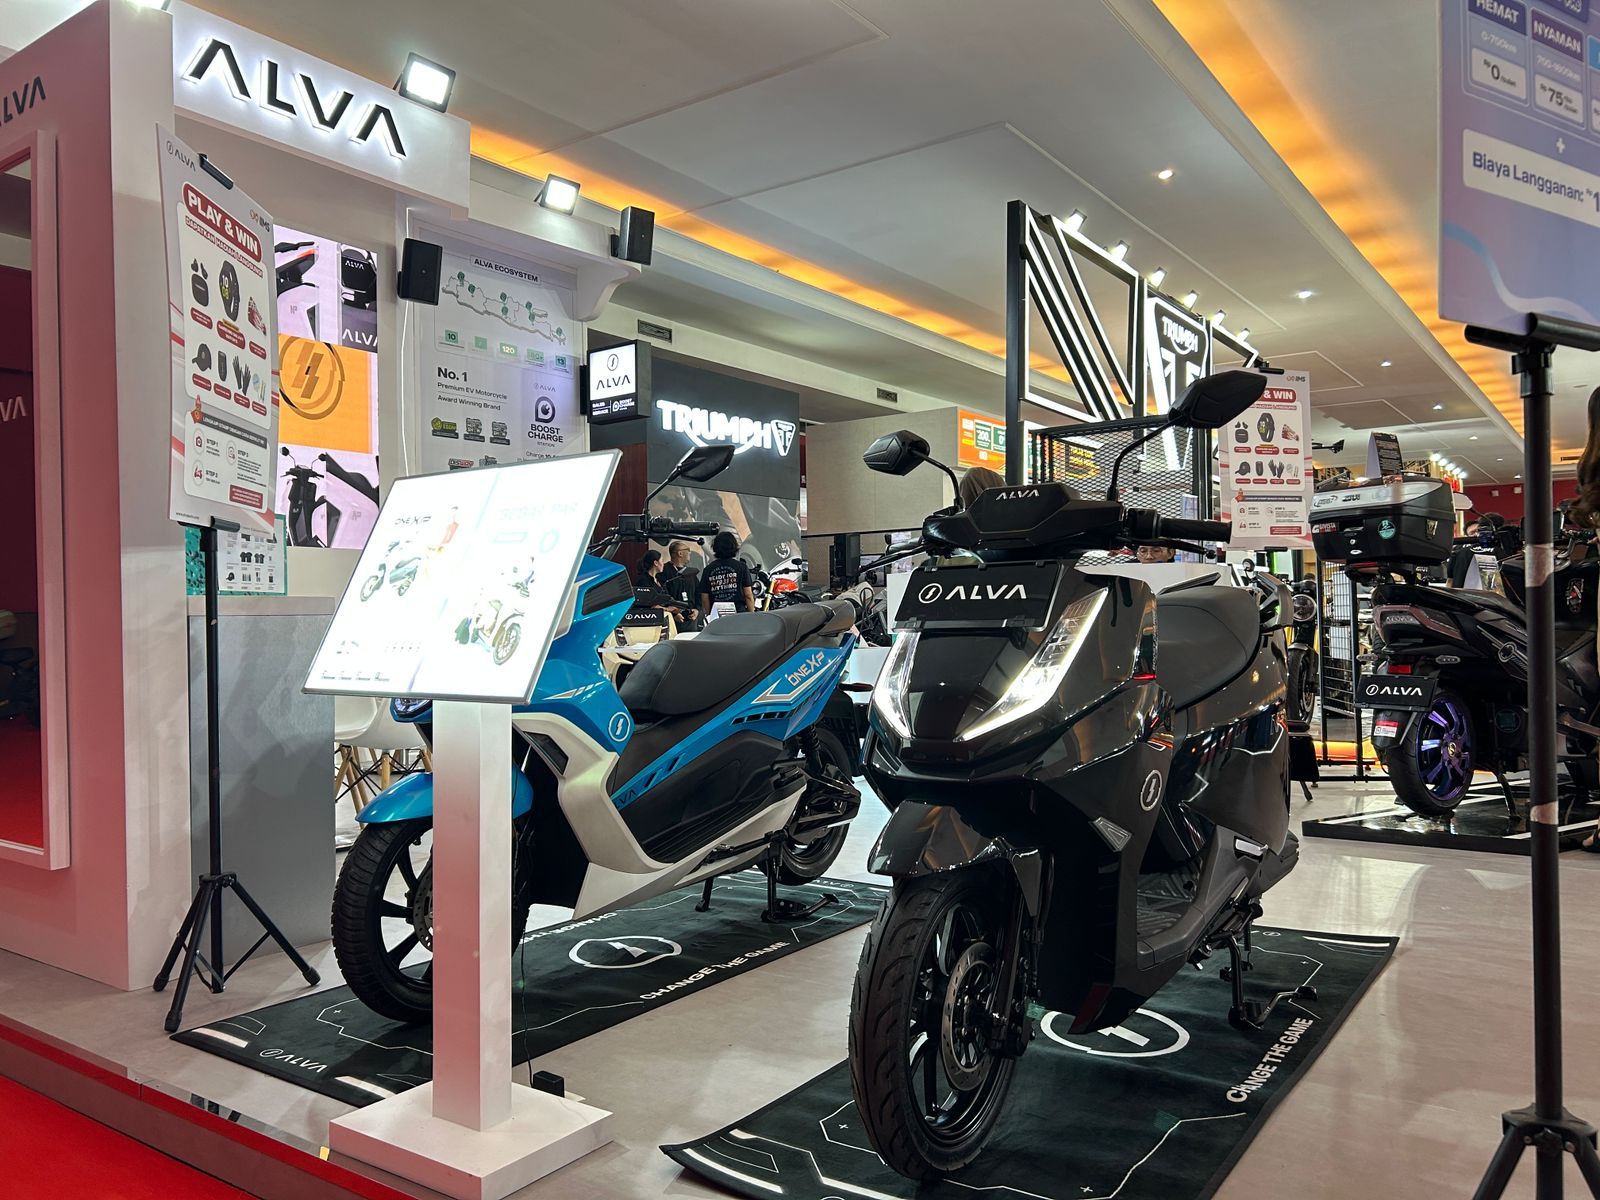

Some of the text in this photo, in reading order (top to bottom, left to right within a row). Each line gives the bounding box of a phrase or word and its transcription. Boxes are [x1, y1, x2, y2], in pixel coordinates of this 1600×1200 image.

[1476, 0, 1520, 24] HEMAT
[1533, 20, 1582, 53] NYAMAN
[1491, 64, 1501, 80] 0
[0, 76, 46, 126] LVA
[184, 38, 408, 158] ALVA
[1548, 87, 1564, 106] 75
[174, 149, 196, 172] ALVA
[1473, 151, 1510, 178] Biaya
[1513, 164, 1584, 202] Langganan:
[187, 189, 259, 256] PLAY & WIN
[345, 260, 365, 271] ALVA
[474, 258, 538, 283] ALVA ECOSYSTEM
[1162, 315, 1199, 355] TRIUMPH
[502, 345, 515, 354] 120
[438, 366, 468, 382] No. 1
[596, 374, 631, 390] ALVA
[437, 382, 508, 400] Premium EV Motorcycle
[539, 385, 556, 393] ALVA
[1264, 390, 1293, 400] & WIN
[437, 394, 501, 411] Award Winning Brand
[530, 423, 560, 435] BOOST
[656, 399, 772, 455] TRIUMPH
[527, 430, 564, 443] CHARGE
[995, 489, 1040, 500] ALVA
[944, 584, 1027, 600] ALVA
[1379, 686, 1423, 696] ALVA
[639, 941, 790, 1000] CHANGE THE GAME
[275, 1054, 328, 1073] ALVA
[1226, 1017, 1314, 1103] CHANGE THE GAME
